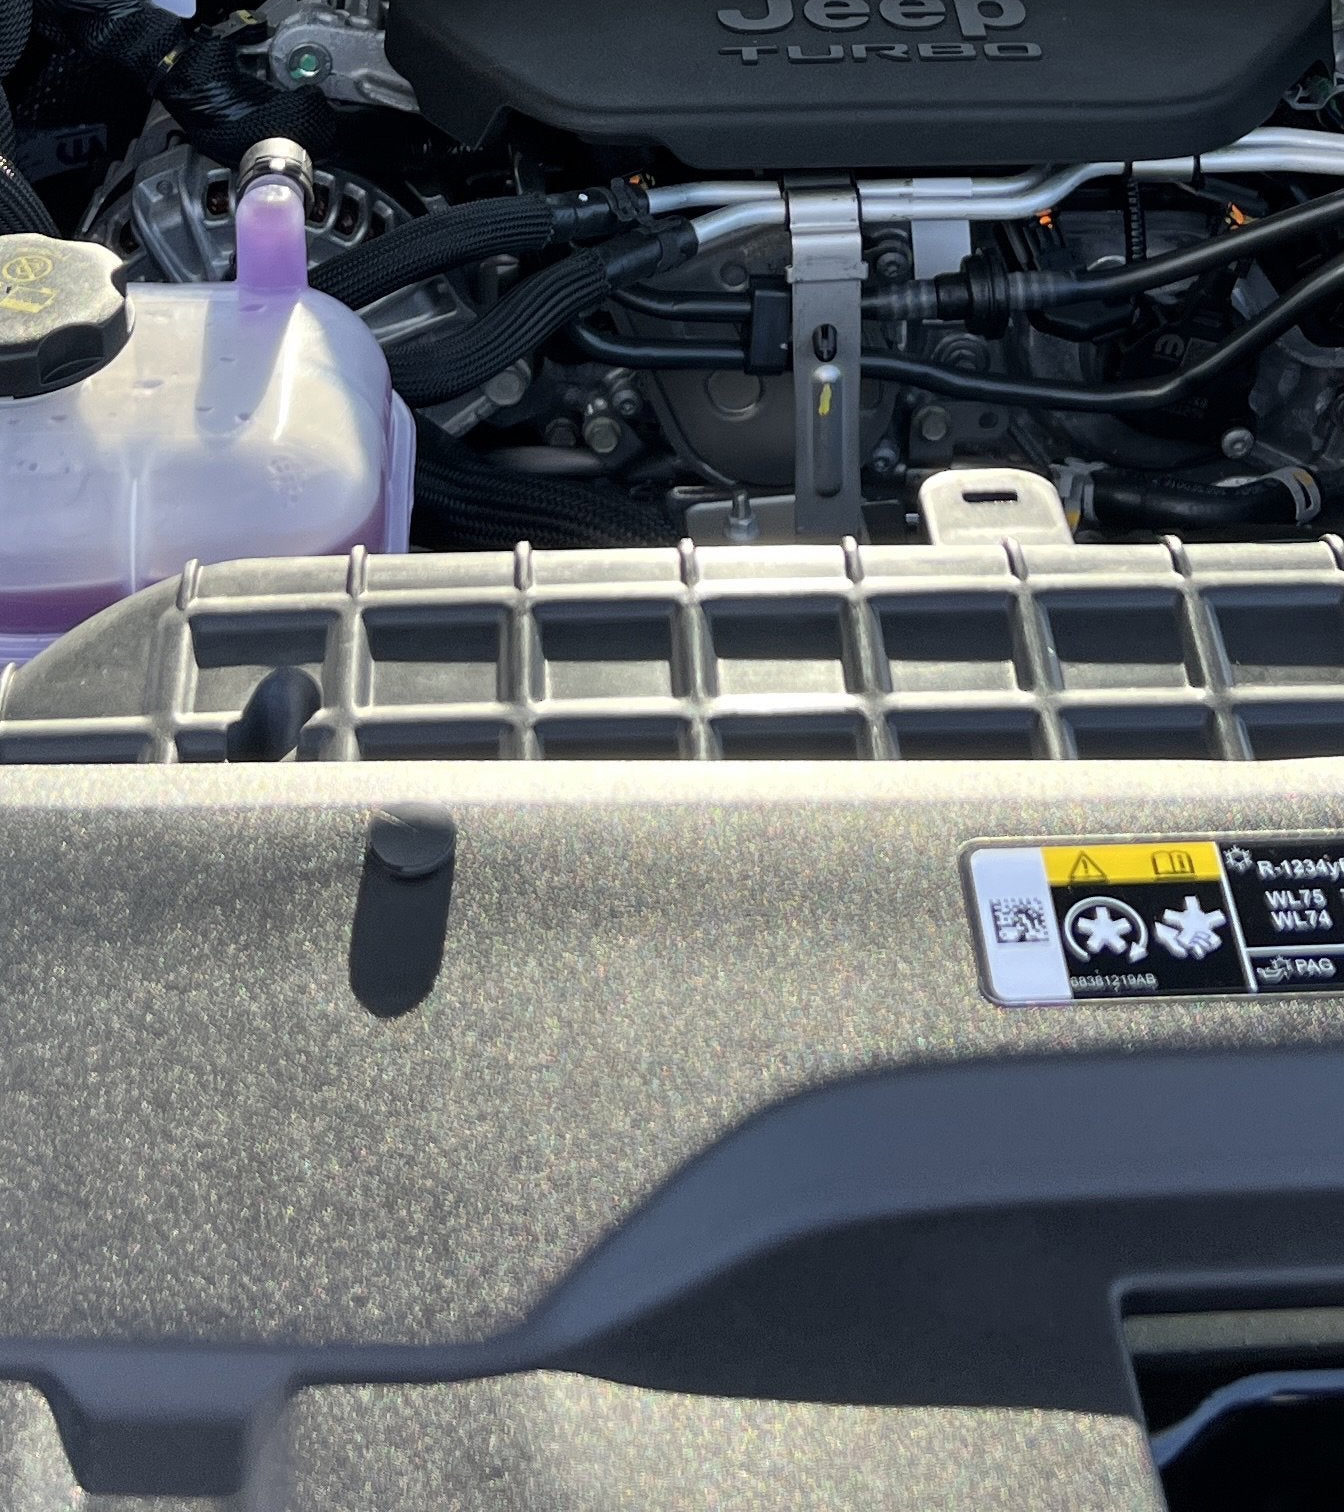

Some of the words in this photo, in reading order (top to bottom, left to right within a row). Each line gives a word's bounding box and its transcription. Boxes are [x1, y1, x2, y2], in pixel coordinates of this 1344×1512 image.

[718, 42, 1043, 65] TURBO
[1264, 888, 1327, 909] WL75
[1270, 908, 1334, 932] WL74
[1294, 957, 1337, 978] PAG
